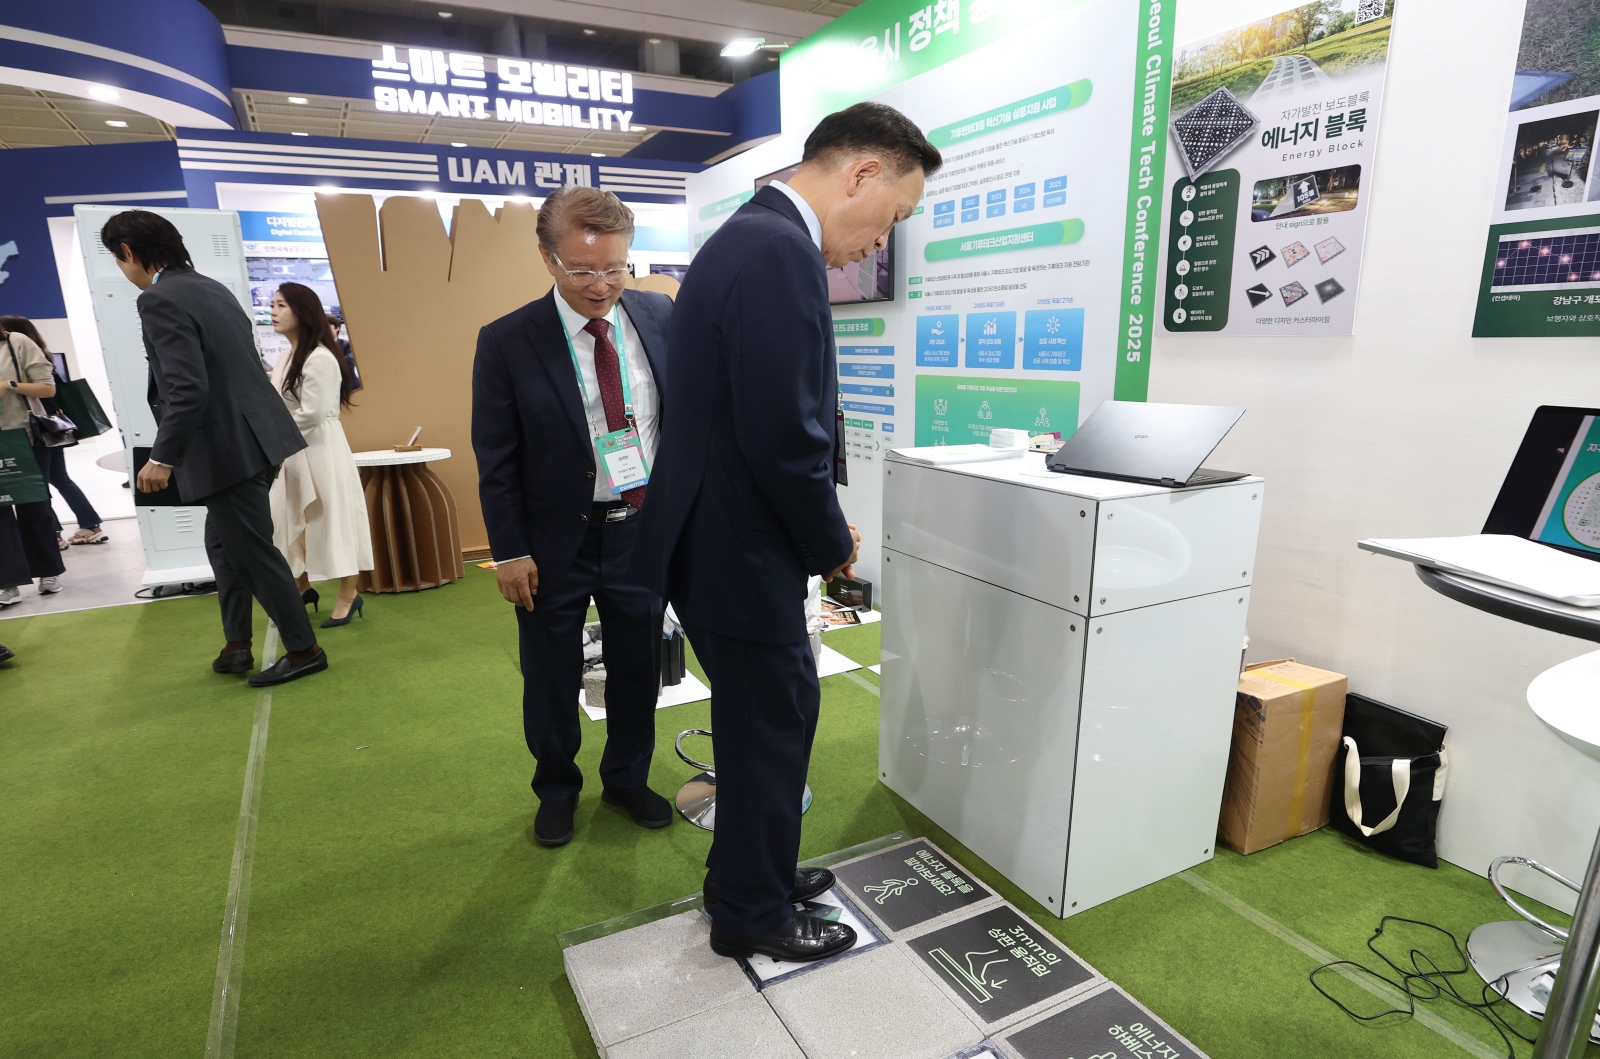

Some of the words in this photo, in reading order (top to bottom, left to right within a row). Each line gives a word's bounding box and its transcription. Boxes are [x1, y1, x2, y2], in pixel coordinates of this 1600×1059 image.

[908, 0, 960, 52] 정책
[1146, 0, 1162, 50] eoul
[372, 45, 487, 89] 스마트
[498, 58, 634, 104] 모빌리티
[1142, 54, 1162, 136] Climate
[374, 86, 489, 118] SMART
[496, 98, 633, 132] MOBILITY
[950, 120, 985, 139] 기후변화대응
[986, 111, 1012, 128] 혁신기술
[1042, 96, 1056, 110] 사업
[1281, 102, 1322, 120] 자가발전
[1325, 91, 1369, 111] 보도블록
[1262, 118, 1319, 149] 에너지
[1325, 108, 1367, 138] 블록
[1138, 140, 1156, 190] Tech
[1282, 148, 1322, 161] Energy
[1329, 140, 1364, 153] Block
[448, 156, 526, 186] UAM
[534, 161, 592, 188] 관제
[1049, 180, 1062, 189] 2025
[271, 228, 294, 236] Digital
[960, 231, 1034, 252] 서울기후테크산업지원센터
[1289, 219, 1314, 229] sign으로
[1317, 217, 1329, 225] 활용
[1130, 196, 1152, 305] Conference
[1553, 295, 1582, 305] 강남구
[1126, 314, 1143, 362] 2025
[904, 857, 955, 896] 밟아보세요!
[916, 850, 947, 872] 에너지
[940, 870, 974, 894] 블록을
[988, 928, 1016, 948] 상판
[1010, 947, 1051, 977] 움직임
[1009, 925, 1061, 965] 3mm의
[1130, 1023, 1180, 1059] 에너지
